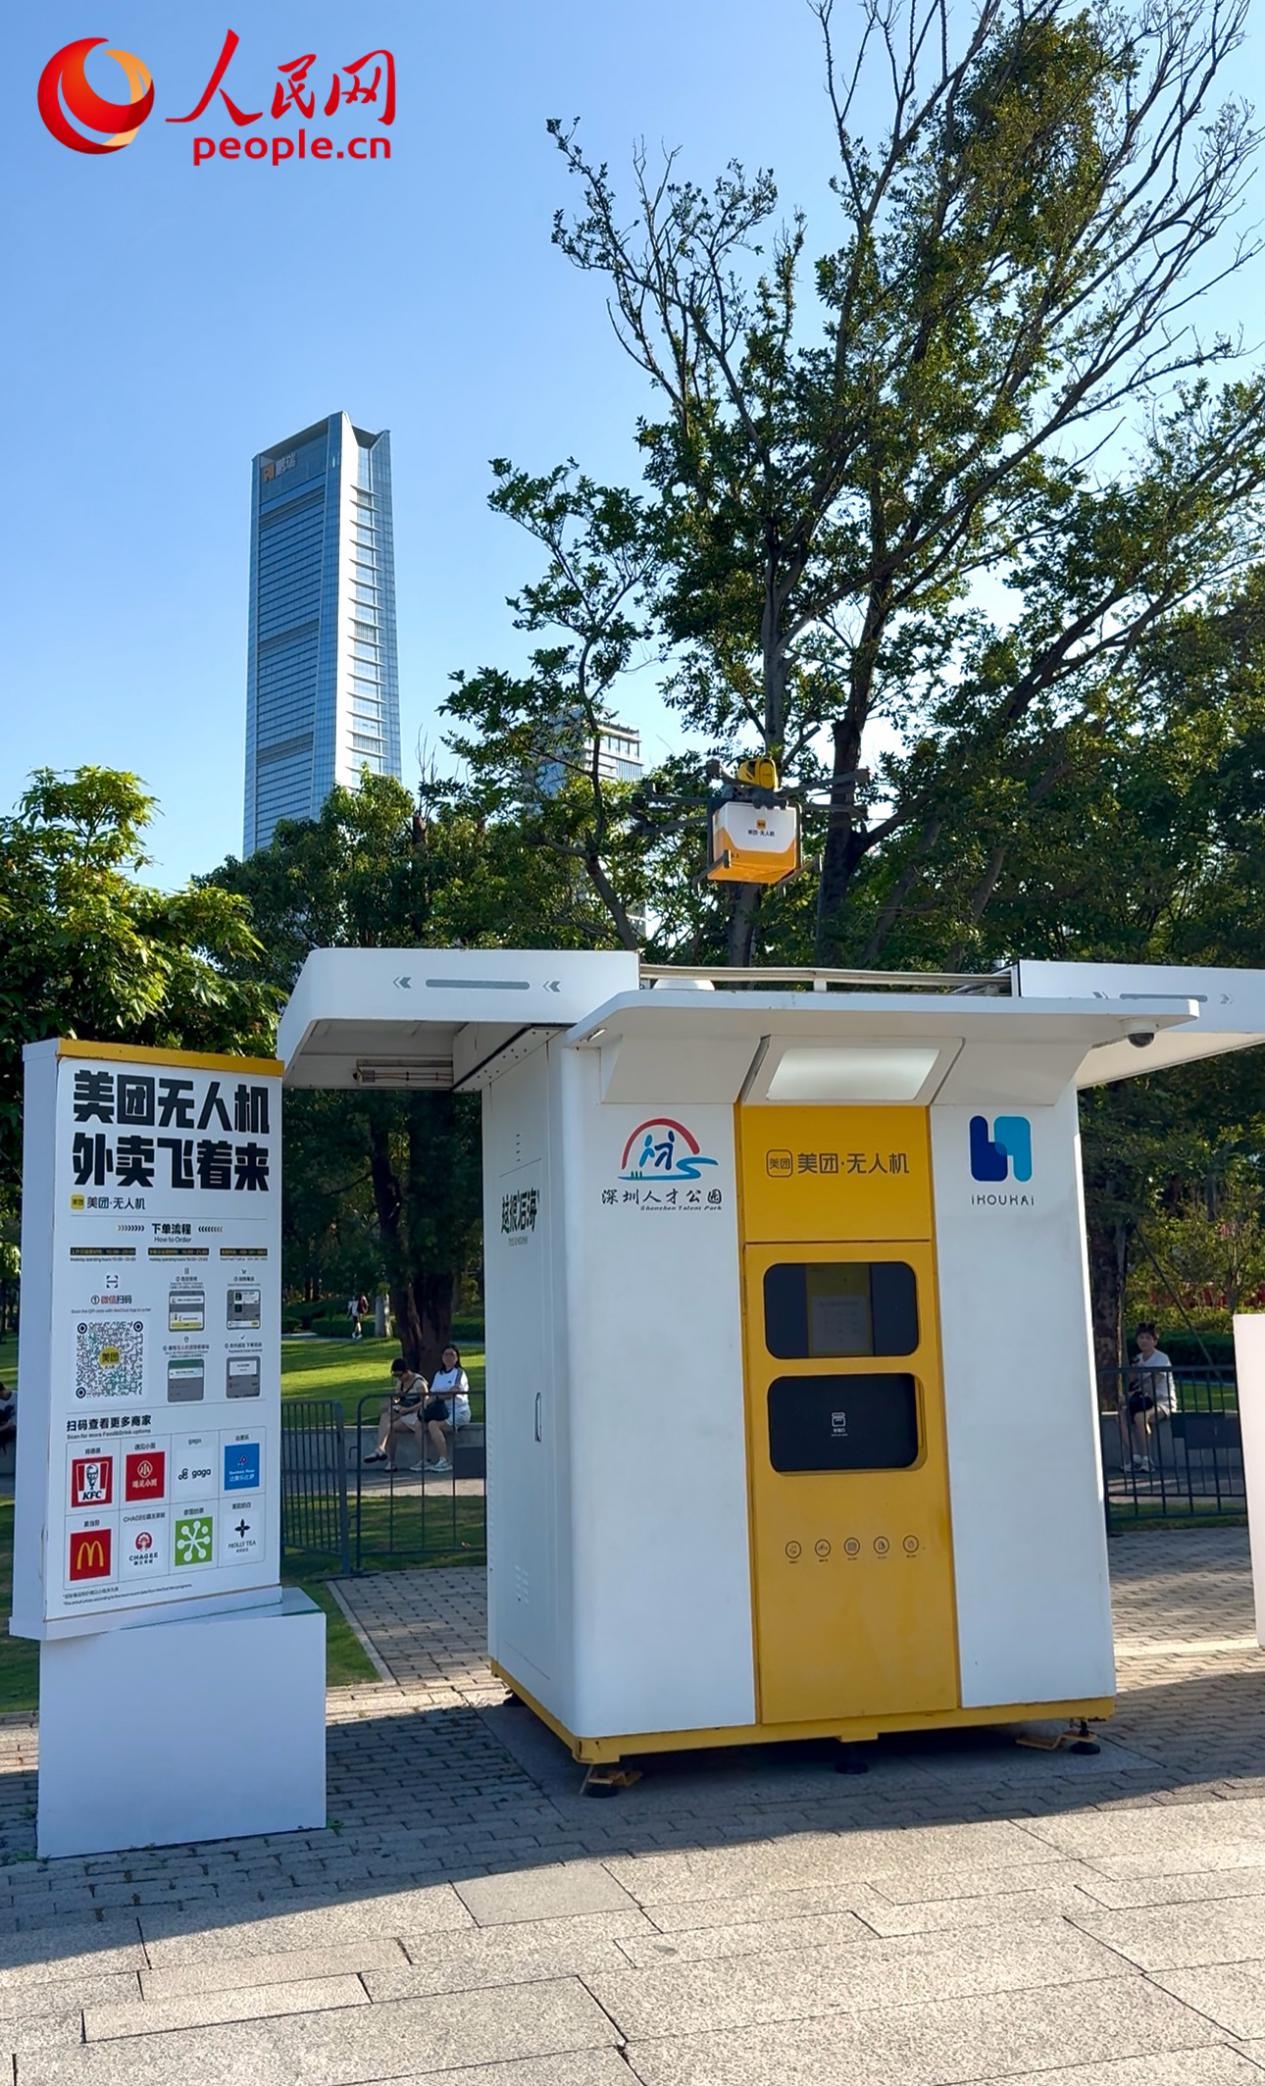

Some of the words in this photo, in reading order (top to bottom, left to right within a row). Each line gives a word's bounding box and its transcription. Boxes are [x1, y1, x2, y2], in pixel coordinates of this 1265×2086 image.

[74, 1070, 270, 1134] 美团无人机
[72, 1132, 269, 1191] 外卖飞着来
[601, 1188, 722, 1205] 深圳人才公园
[152, 1223, 191, 1235] 下单流程
[66, 1414, 152, 1432] 扫码查看更多商家
[192, 1468, 212, 1479] gogo
[82, 1490, 102, 1500] KFC
[129, 1552, 158, 1561] CHAGEE
